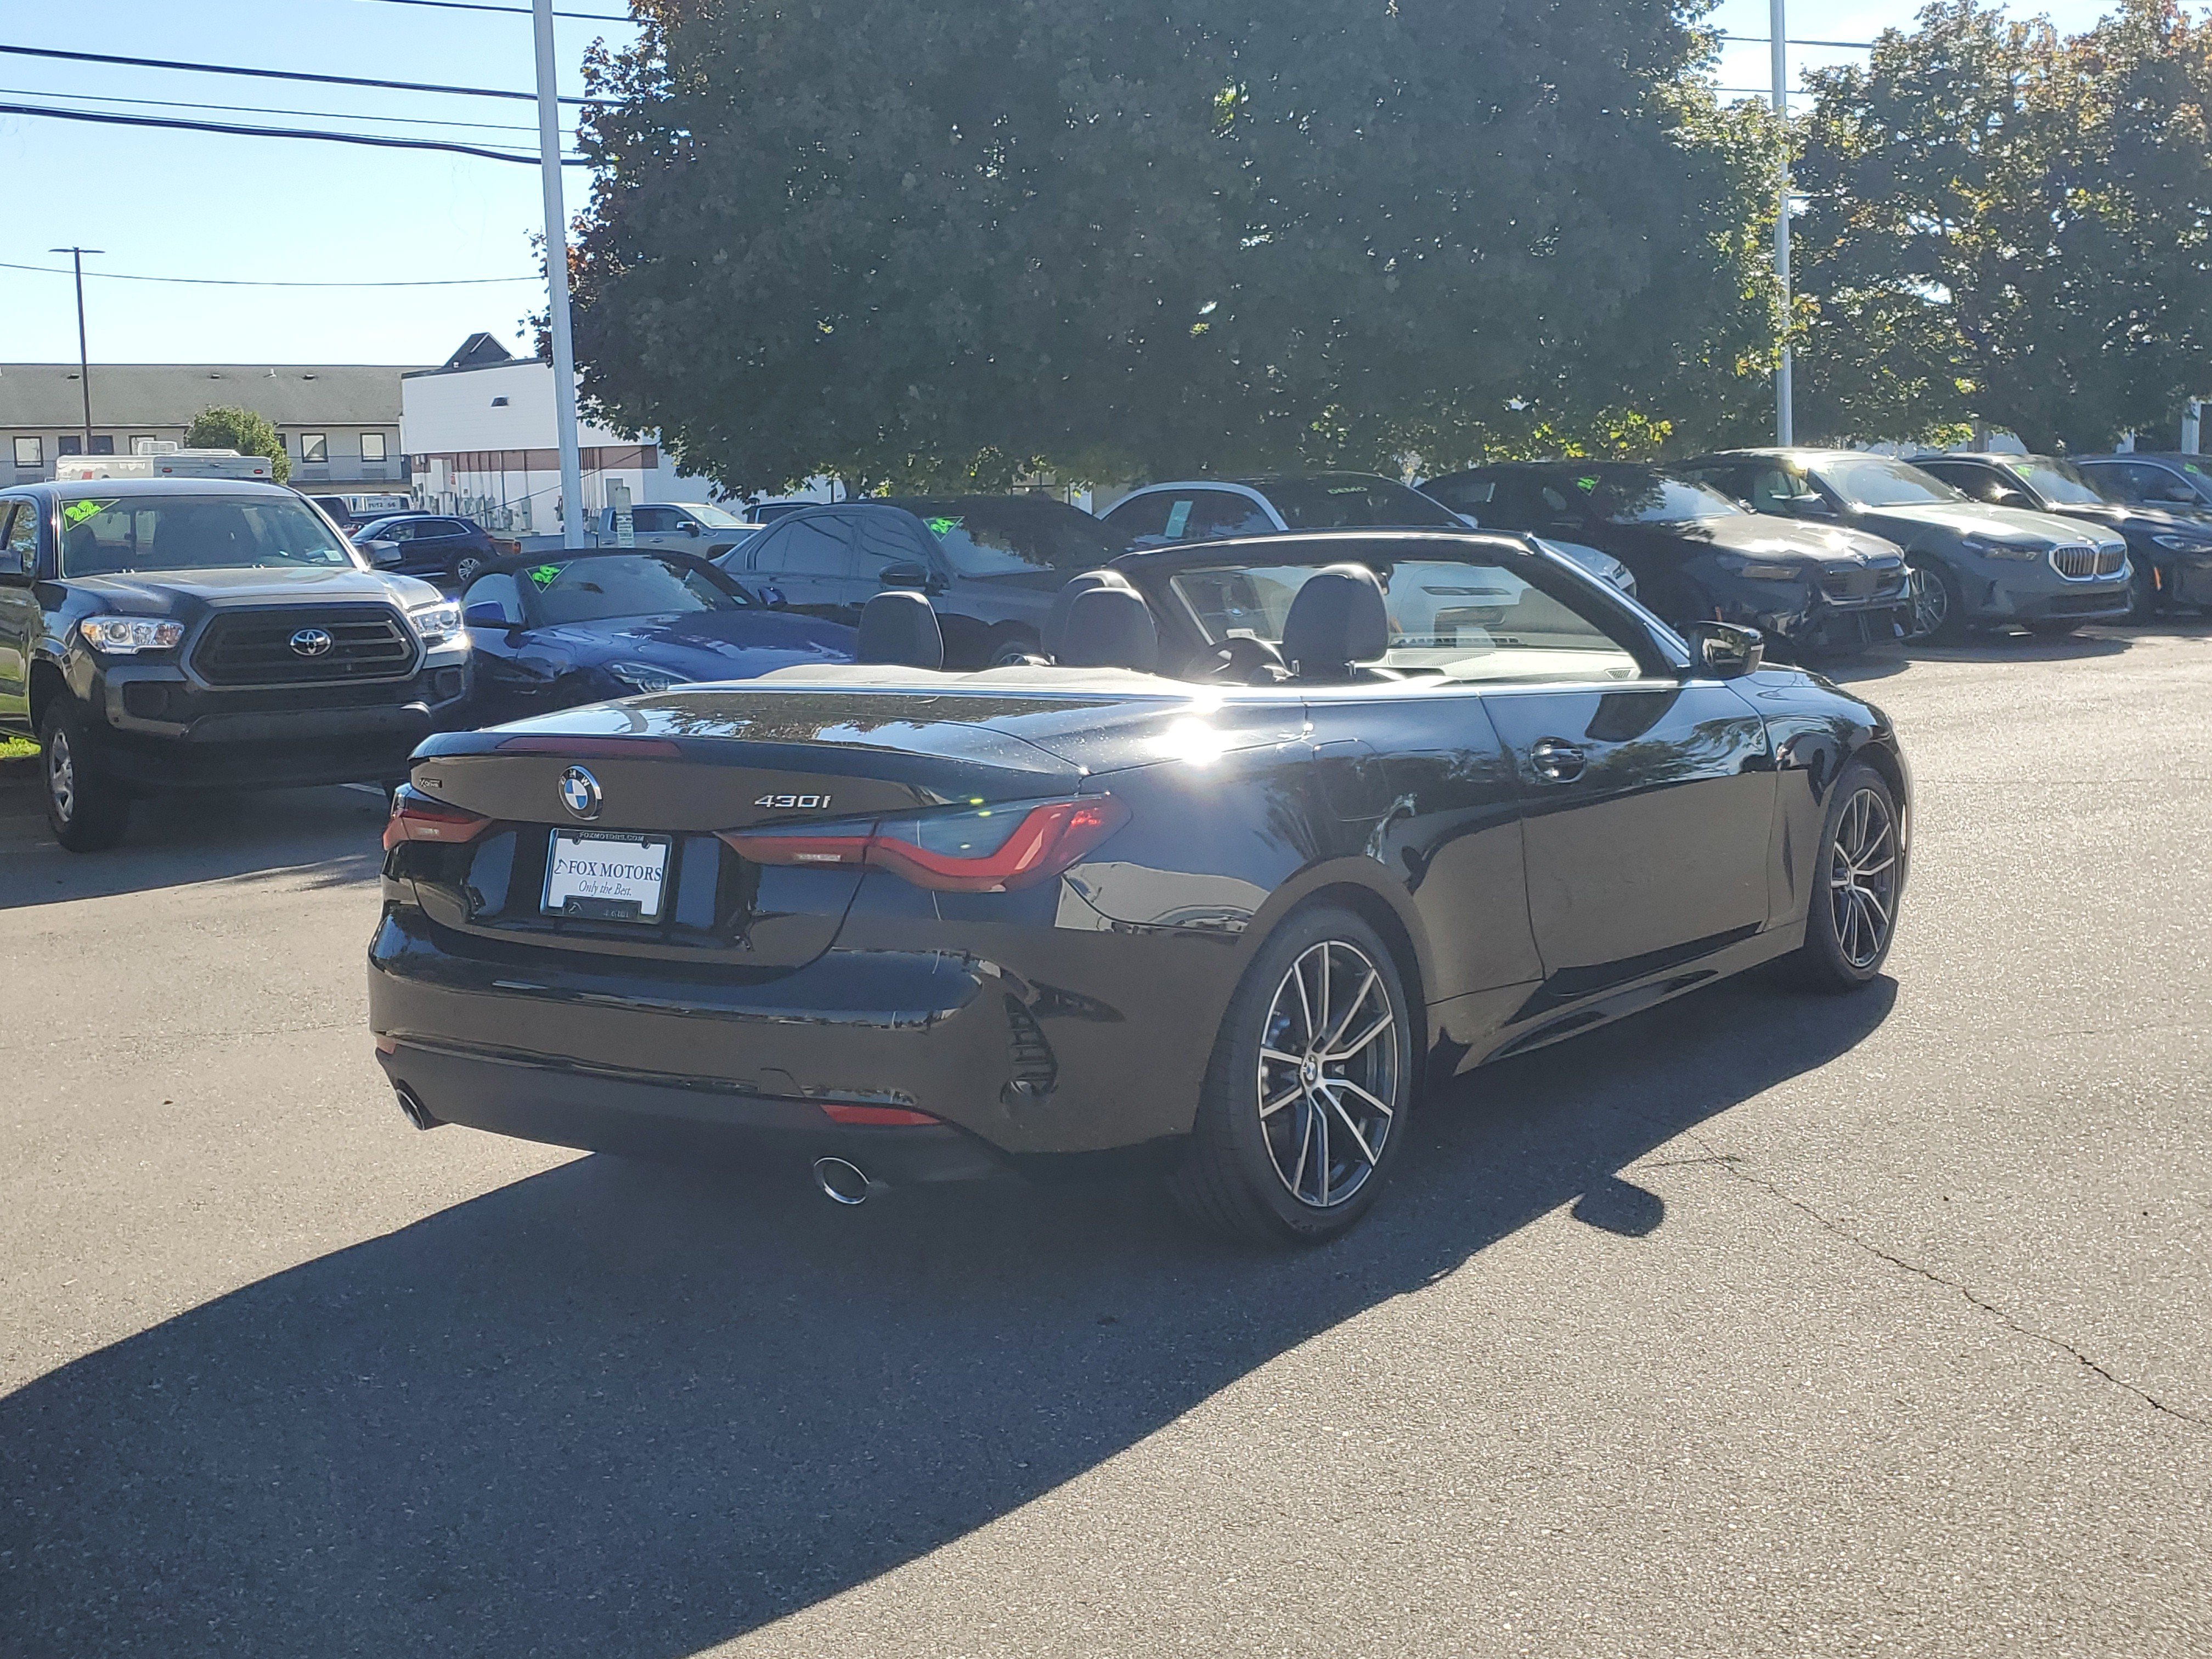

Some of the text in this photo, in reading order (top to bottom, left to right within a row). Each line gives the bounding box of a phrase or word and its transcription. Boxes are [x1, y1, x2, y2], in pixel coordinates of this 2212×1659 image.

[65, 500, 101, 521] 22
[754, 795, 832, 809] 430i
[579, 831, 645, 842] FOXMOTORS.COM
[567, 860, 662, 882] FOX MOTORS
[579, 879, 632, 896] Only the Best.
